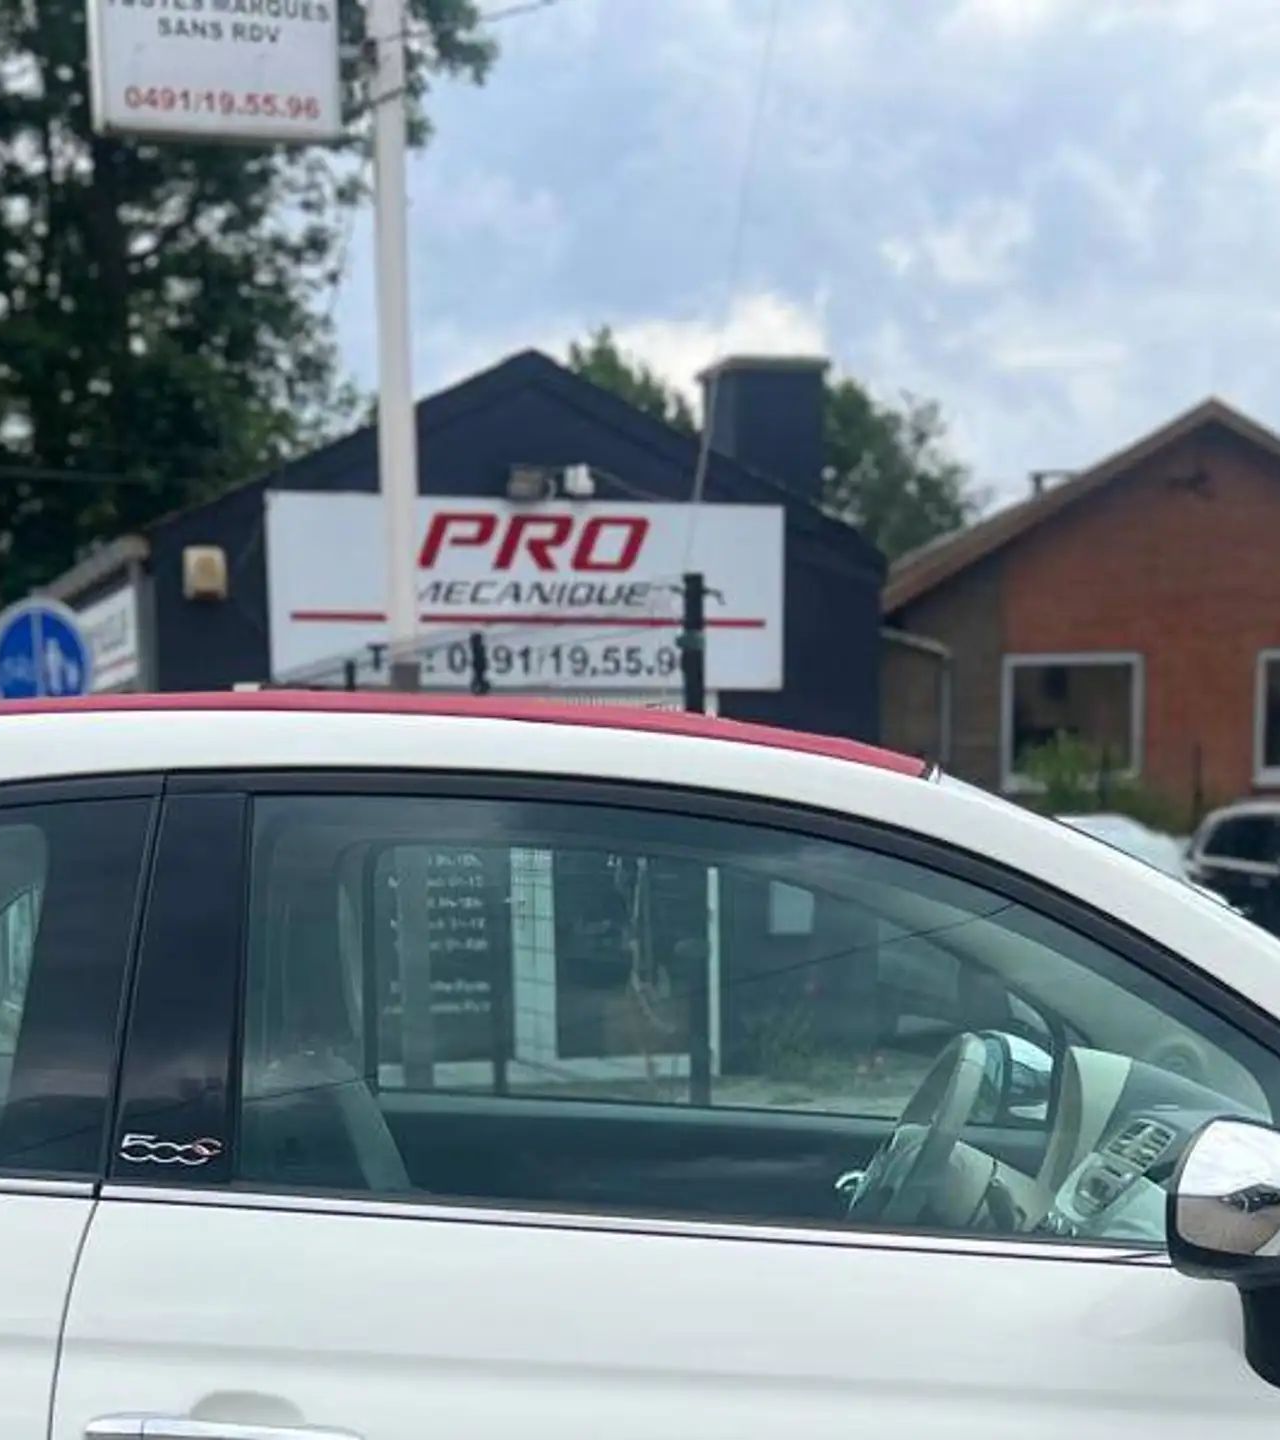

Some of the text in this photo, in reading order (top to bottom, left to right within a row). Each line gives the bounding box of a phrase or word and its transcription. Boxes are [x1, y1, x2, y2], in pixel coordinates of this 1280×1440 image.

[211, 0, 330, 23] MARQUES
[157, 16, 282, 44] SANS RDV
[123, 84, 322, 120] 0491/19.55.96
[417, 511, 651, 574] PRO
[446, 640, 685, 679] 091/19.55.9
